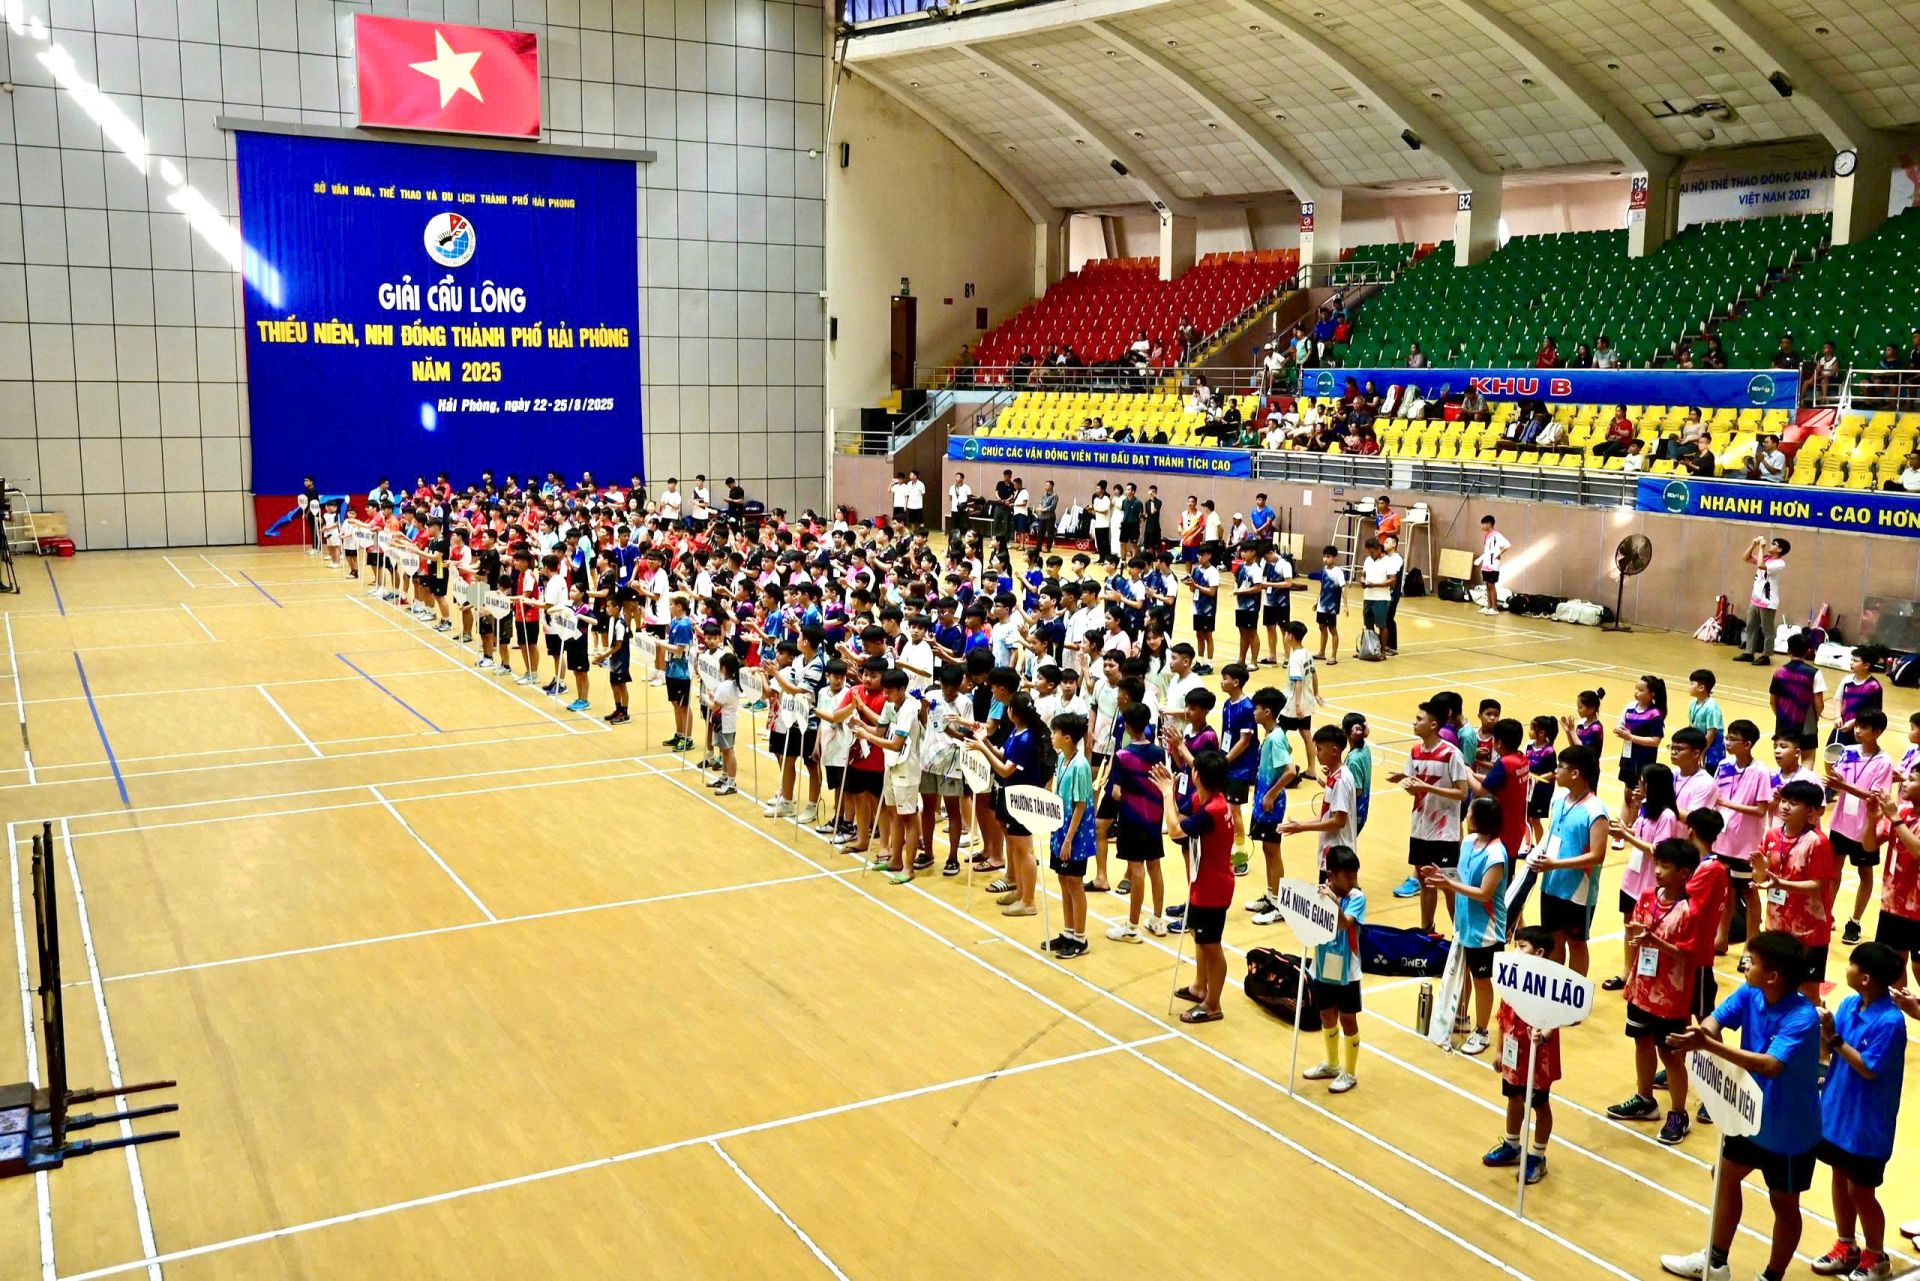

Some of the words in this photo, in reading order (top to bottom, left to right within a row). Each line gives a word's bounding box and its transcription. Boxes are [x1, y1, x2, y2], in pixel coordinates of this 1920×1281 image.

[1633, 177, 1647, 191] B2
[1731, 175, 1758, 189] THAO
[1793, 168, 1818, 182] NAM
[331, 183, 349, 195] VĂN
[400, 189, 422, 200] THAO
[441, 192, 454, 202] DU
[458, 193, 475, 204] LỊCH
[481, 193, 507, 205] THÀNH
[512, 194, 529, 206] PHỐ
[1459, 194, 1471, 210] B2
[1738, 191, 1760, 208] VIỆT
[1762, 191, 1785, 203] NAM
[1788, 188, 1810, 201] 2021
[1302, 204, 1313, 215] B3
[378, 274, 420, 311] GIẢI
[427, 274, 463, 312] CẦU
[470, 280, 527, 313] LÔNG
[257, 314, 307, 343] THIẾU
[313, 318, 360, 348] NIÊN,
[365, 324, 394, 346] NHI
[451, 321, 505, 347] THÀNH
[511, 321, 543, 348] PHỐ
[547, 321, 574, 348] HẢI
[579, 323, 629, 348] PHÒNG
[412, 356, 451, 382] NĂM
[462, 361, 502, 382] 2025
[1470, 376, 1538, 395] KHU
[1550, 378, 1572, 396] B
[437, 397, 458, 413] Hải
[504, 397, 531, 413] ngày
[981, 444, 1003, 457] CHÚC
[1006, 444, 1023, 458] CÁC
[1025, 446, 1042, 460] VẬN
[1045, 447, 1069, 462] ĐỘNG
[1071, 448, 1091, 462] VIÊN
[1094, 452, 1109, 463] THI
[1111, 450, 1129, 465] ĐẤU
[1132, 454, 1151, 467] ĐẠT
[1153, 454, 1184, 468] THÀNH
[1187, 455, 1209, 470] TÍCH
[1211, 460, 1231, 472] CAO
[1700, 495, 1762, 515] NHANH
[1769, 500, 1810, 519] HƠN
[1830, 505, 1871, 524] CAO
[1878, 508, 1920, 529] HƠN
[1010, 793, 1033, 813] PHƯỜNG
[1280, 886, 1292, 909] XÃ
[1292, 895, 1310, 918] NING
[1311, 903, 1335, 933] GIANG
[1497, 962, 1519, 989] XÃ
[1522, 971, 1547, 998] AN
[1551, 978, 1585, 1008] LÃO
[1691, 1050, 1723, 1095] PHƯỜNG
[1723, 1076, 1738, 1108] GIA
[1738, 1088, 1756, 1125] VIÊN
